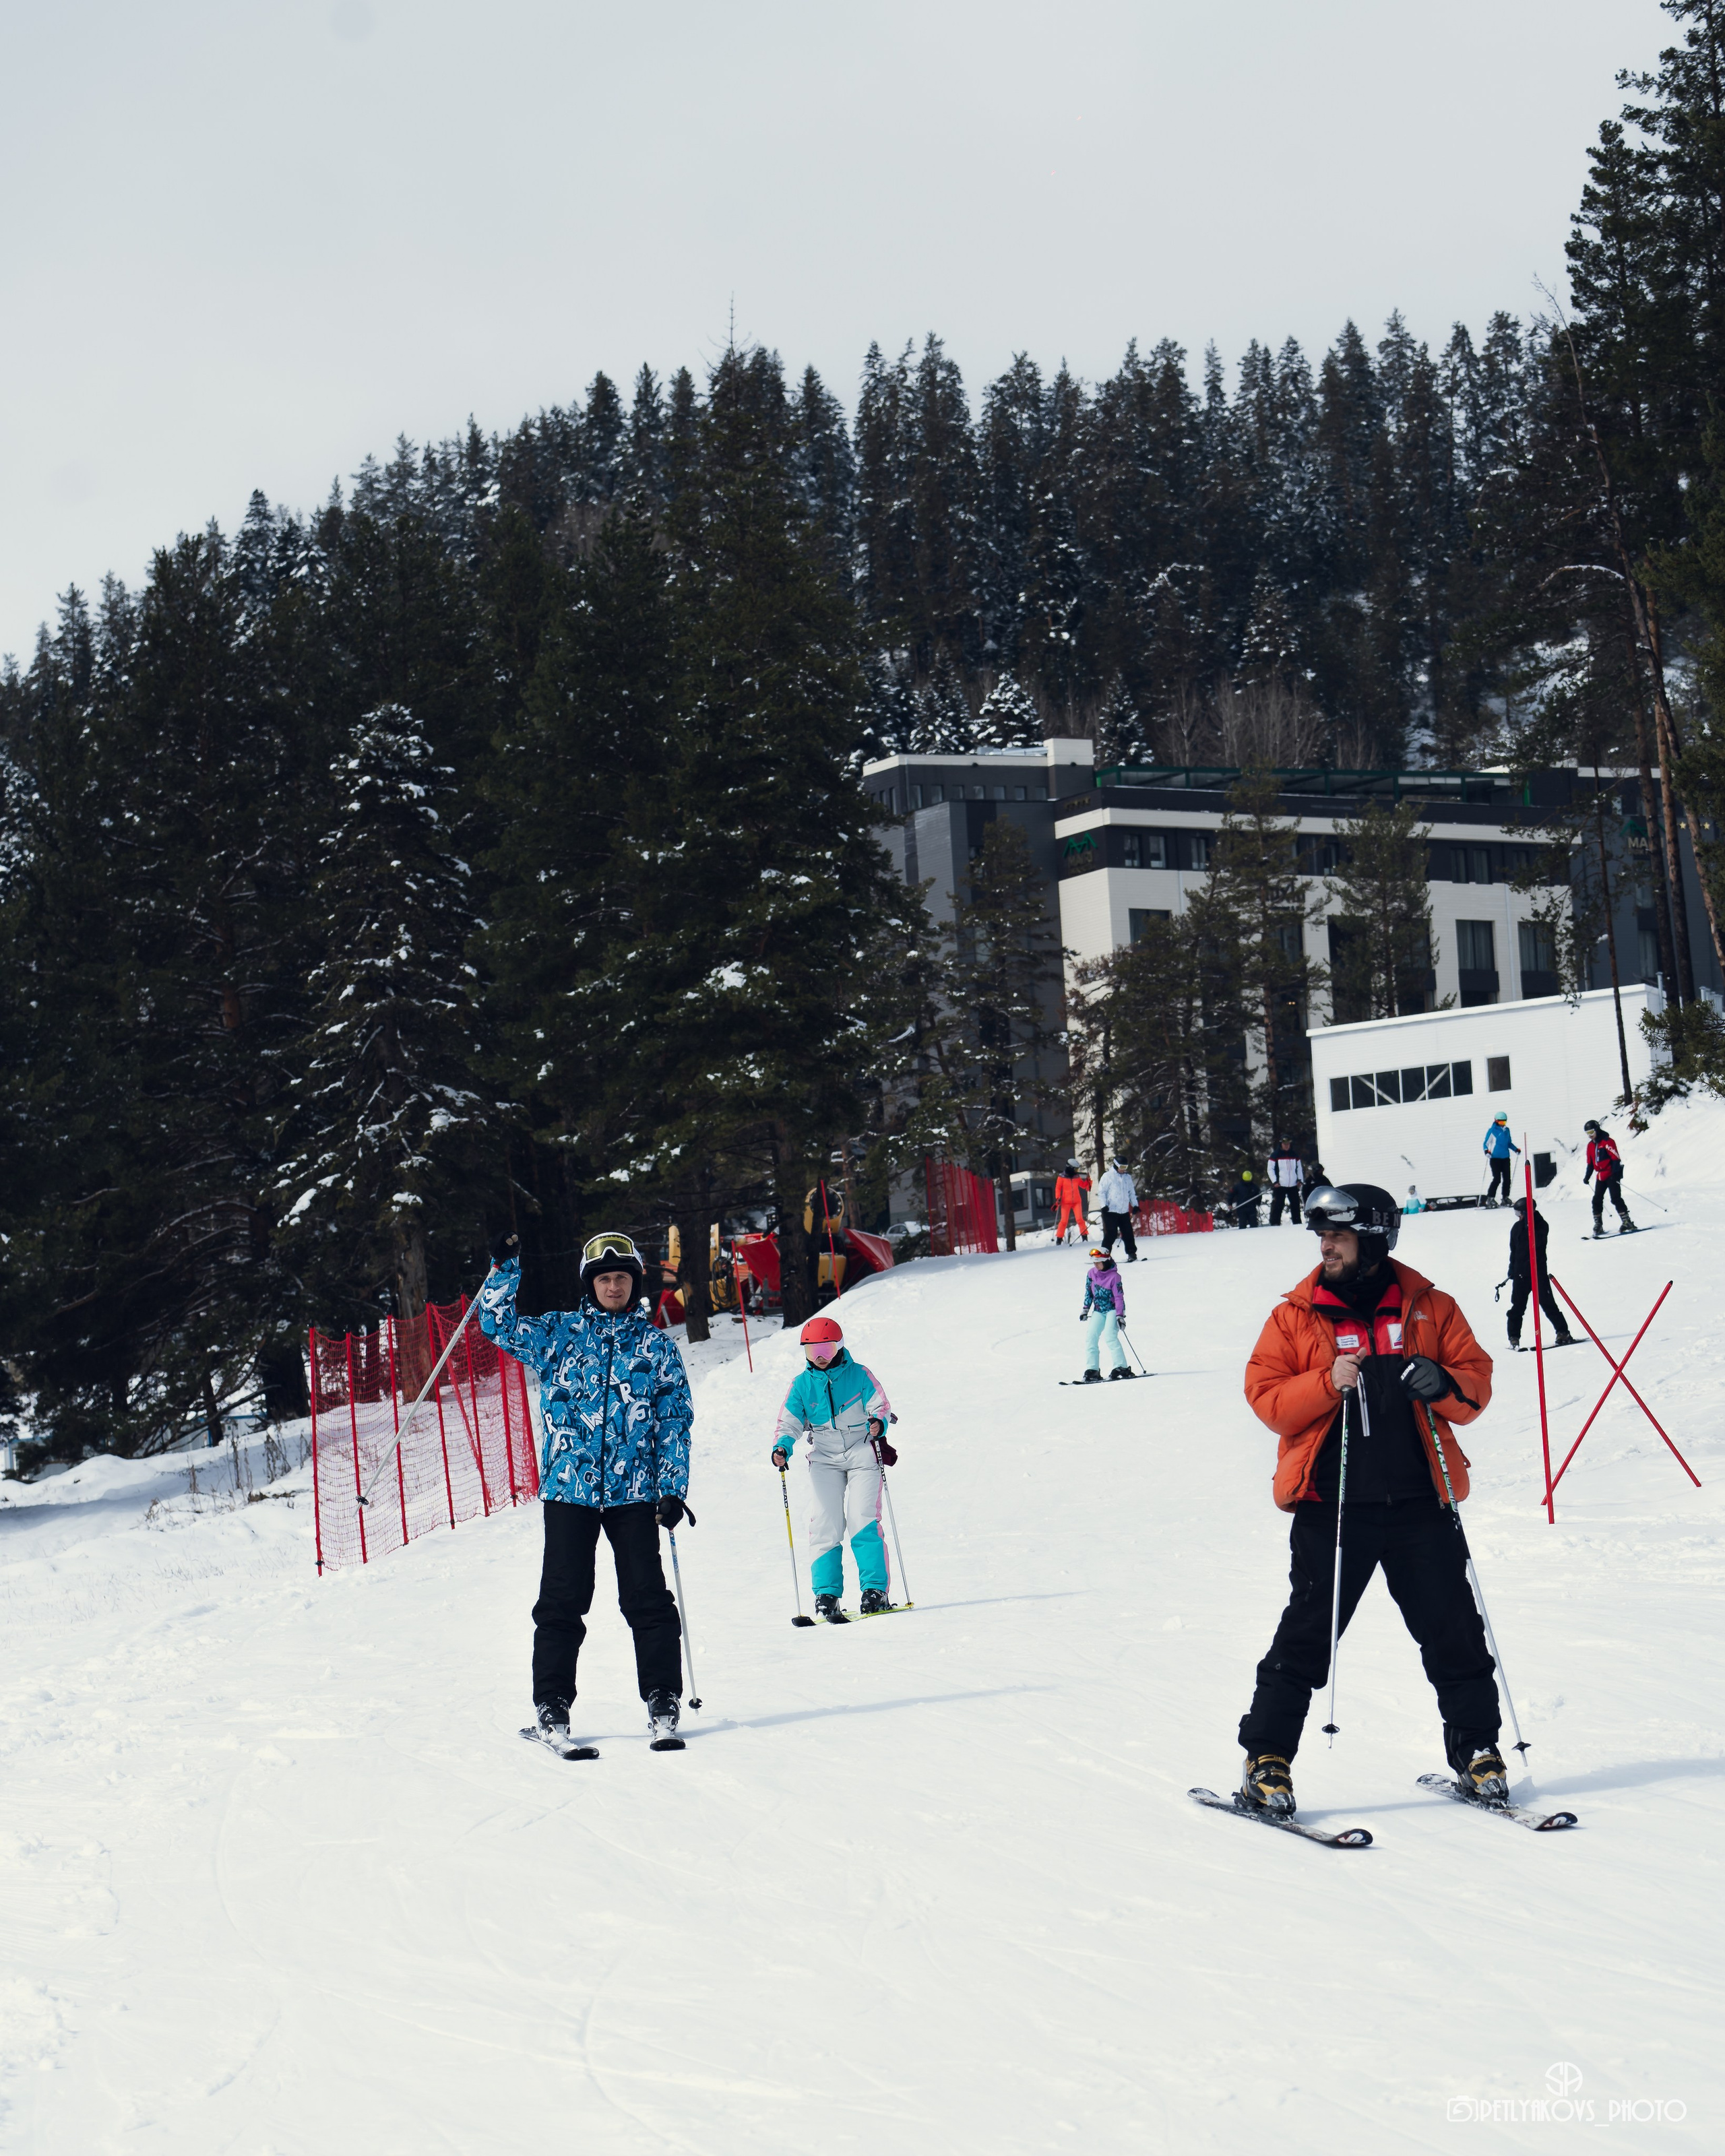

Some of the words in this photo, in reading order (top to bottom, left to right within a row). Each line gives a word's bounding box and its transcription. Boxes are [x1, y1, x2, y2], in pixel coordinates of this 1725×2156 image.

[1372, 1210, 1389, 1226] BE
[466, 1298, 480, 1318] COBER
[877, 1451, 886, 1482] HEAD
